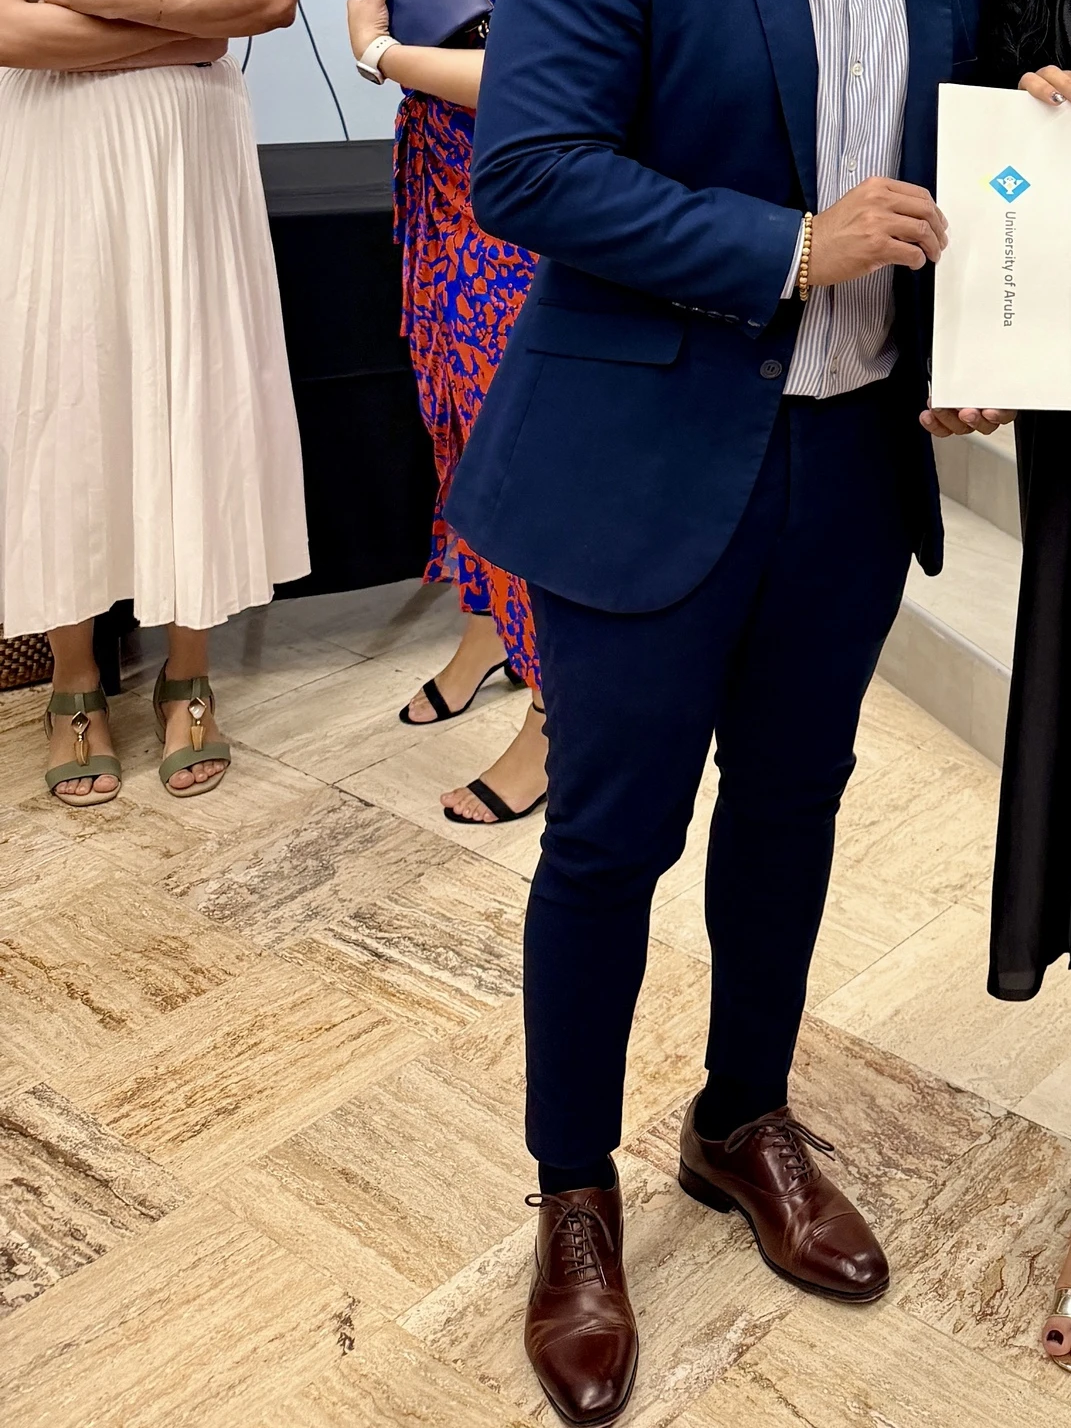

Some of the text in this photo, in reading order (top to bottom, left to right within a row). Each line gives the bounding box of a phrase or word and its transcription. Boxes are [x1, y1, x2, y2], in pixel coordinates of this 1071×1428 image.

[1001, 211, 1017, 327] University of Aruba
